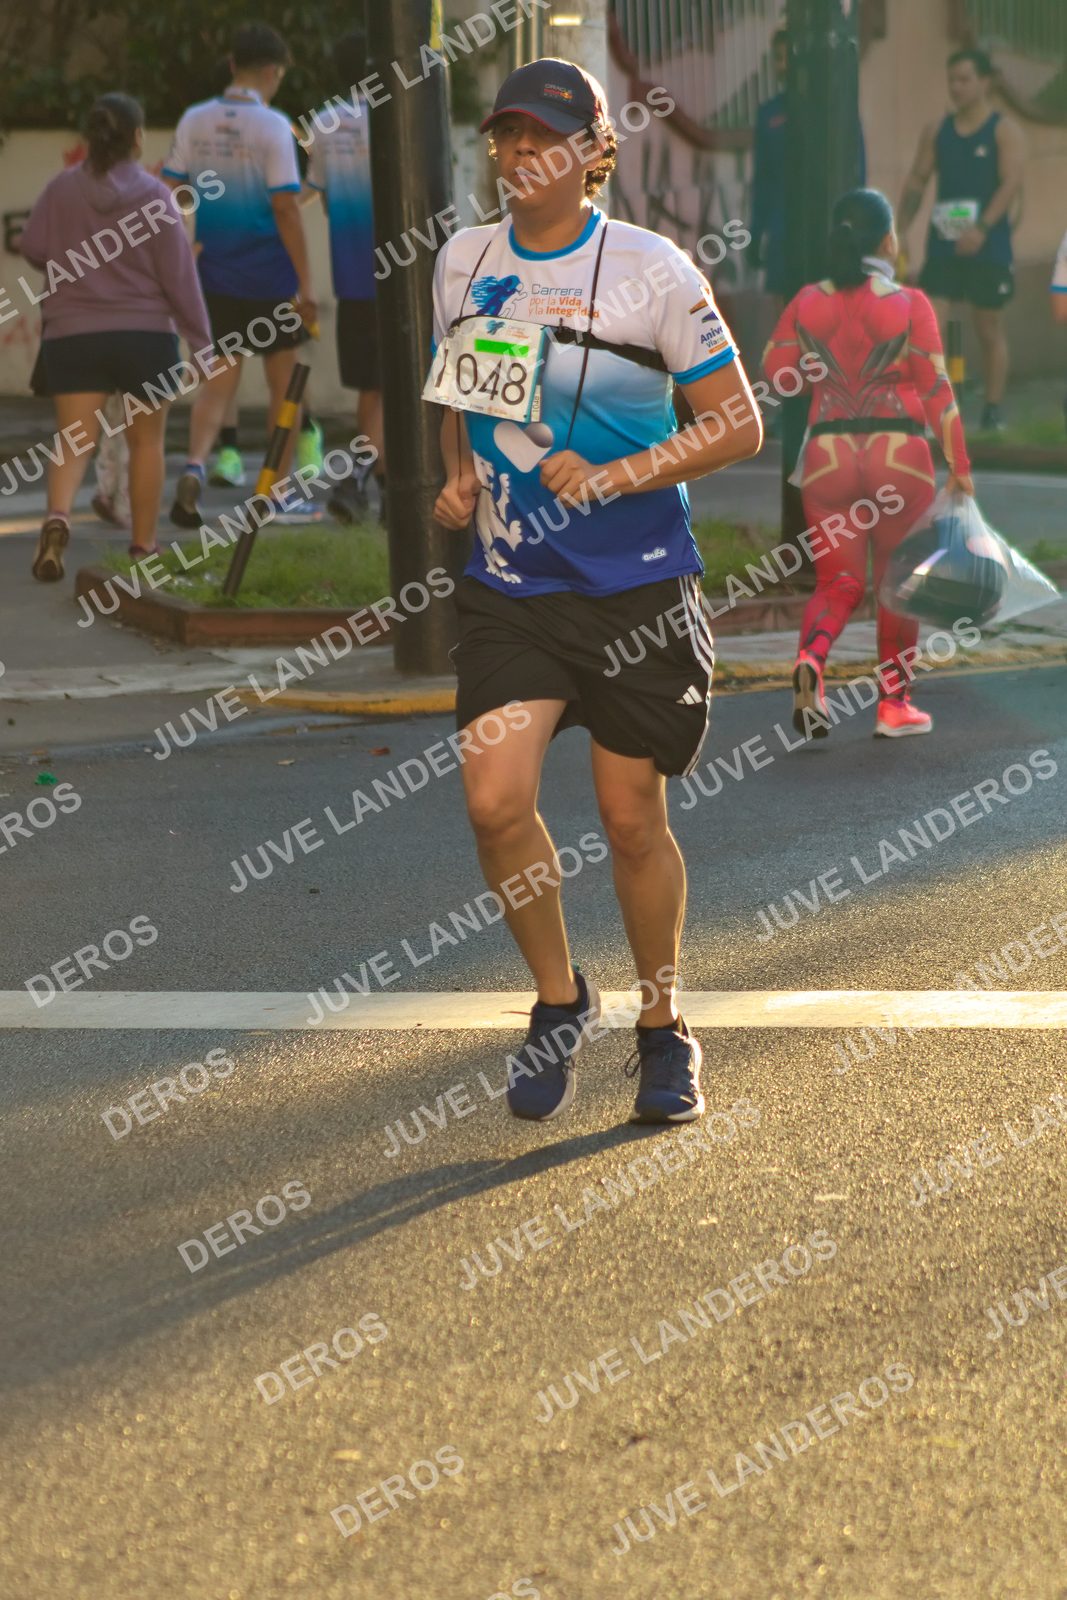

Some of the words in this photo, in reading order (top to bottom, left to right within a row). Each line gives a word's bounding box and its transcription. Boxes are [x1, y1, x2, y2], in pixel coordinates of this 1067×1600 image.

[531, 283, 583, 297] Carrera
[529, 297, 545, 307] por
[547, 295, 556, 305] la
[559, 296, 582, 307] Vida
[528, 307, 534, 319] y
[535, 305, 544, 315] la
[434, 349, 528, 405] 1048
